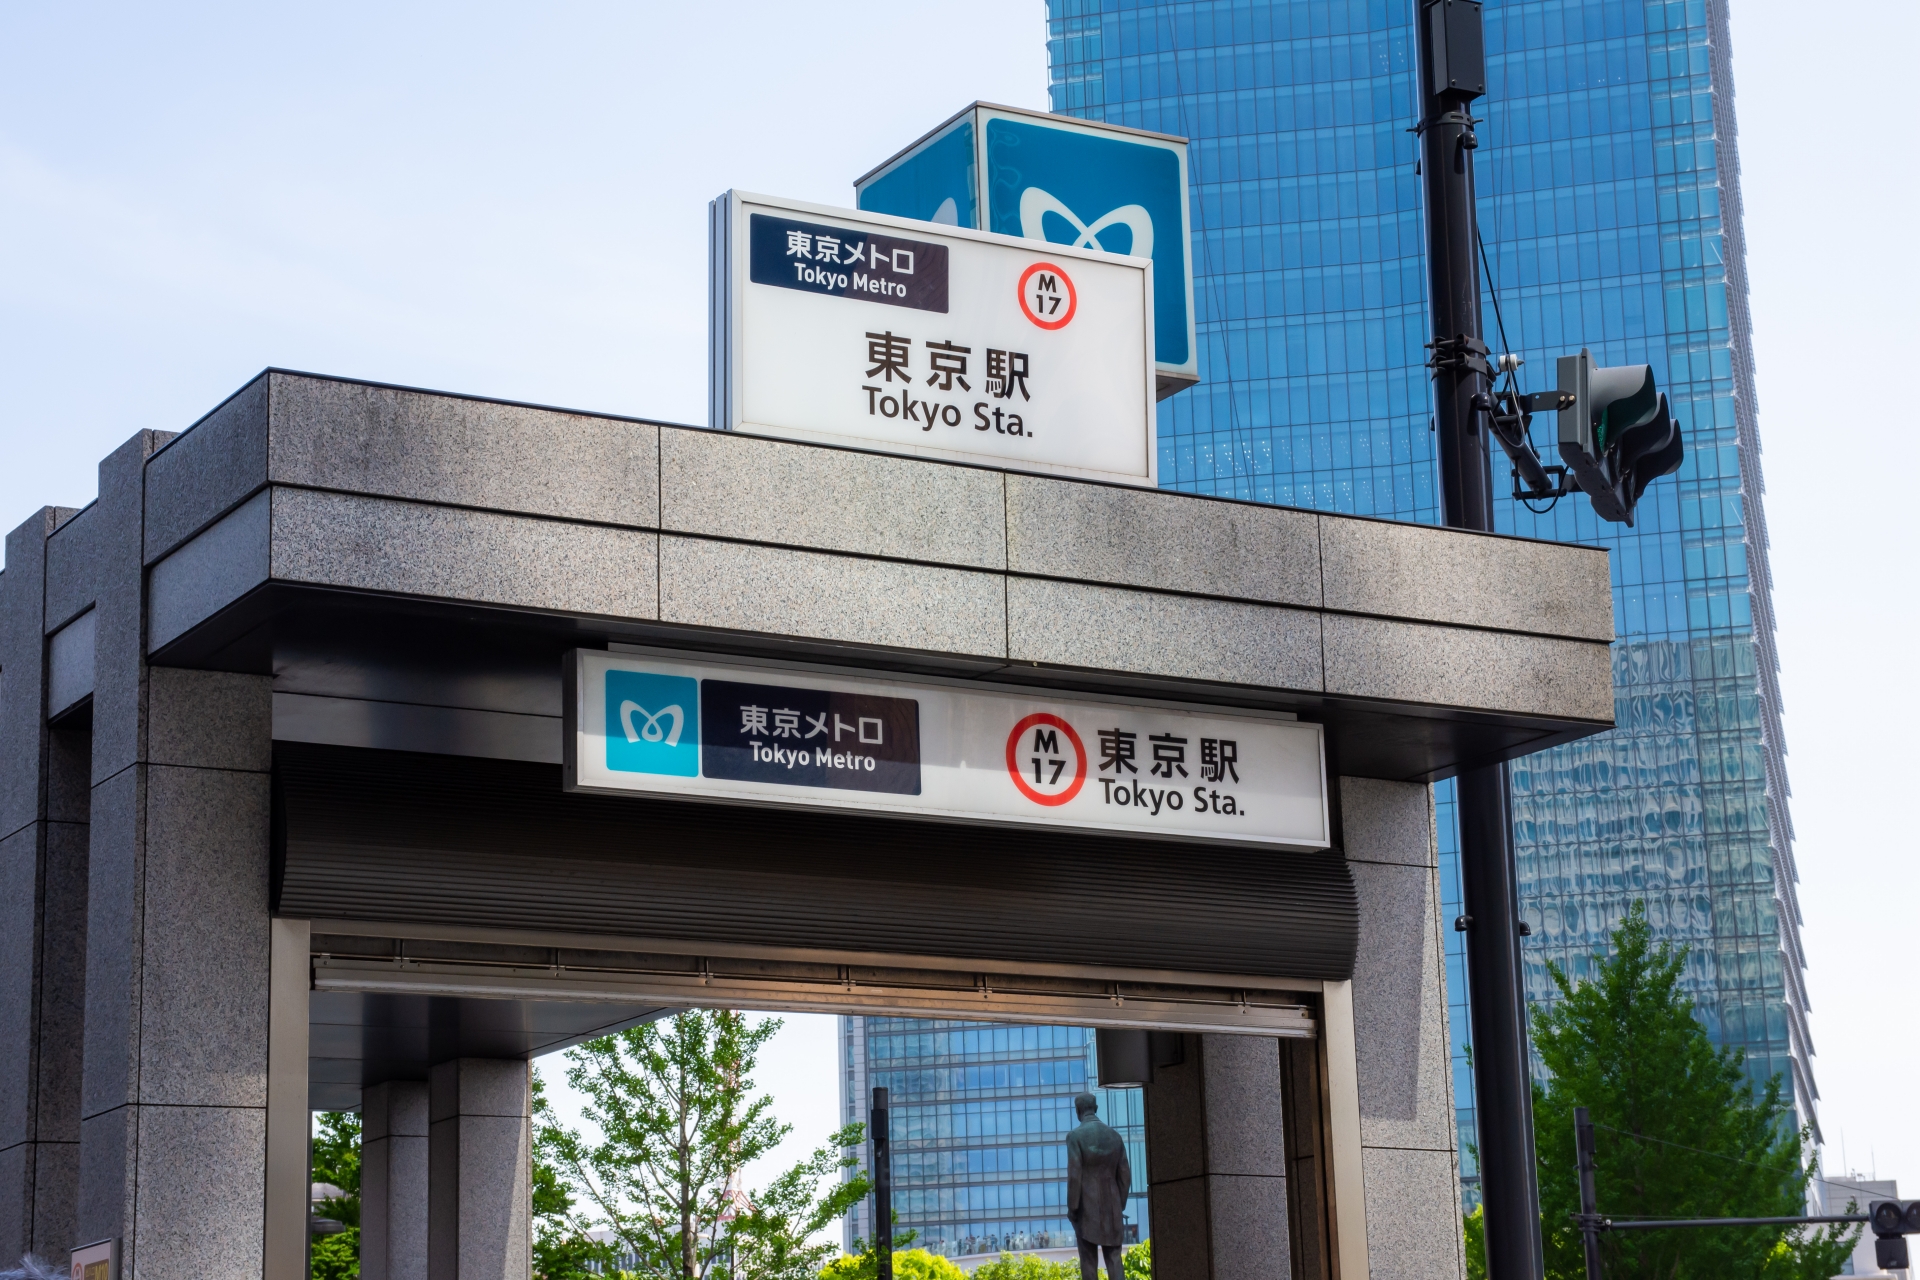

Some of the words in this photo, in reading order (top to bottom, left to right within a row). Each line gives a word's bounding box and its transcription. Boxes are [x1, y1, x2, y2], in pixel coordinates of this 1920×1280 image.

[786, 230, 914, 275] 東京メトロ
[794, 263, 848, 289] Tokyo
[852, 275, 907, 298] Metro
[1038, 274, 1057, 294] M
[1035, 295, 1062, 315] 17
[865, 331, 1031, 402] 東京駅
[862, 385, 961, 431] Tokyo
[973, 402, 1034, 437] Sta.
[739, 705, 883, 745] 東京メトロ
[1034, 729, 1060, 755] M
[750, 741, 810, 769] Tokyo
[815, 748, 876, 771] Metro
[1032, 758, 1067, 785] 17
[1097, 728, 1239, 784] 東京駅
[1098, 778, 1184, 815] Tokyo
[1194, 787, 1245, 816] Sta.
